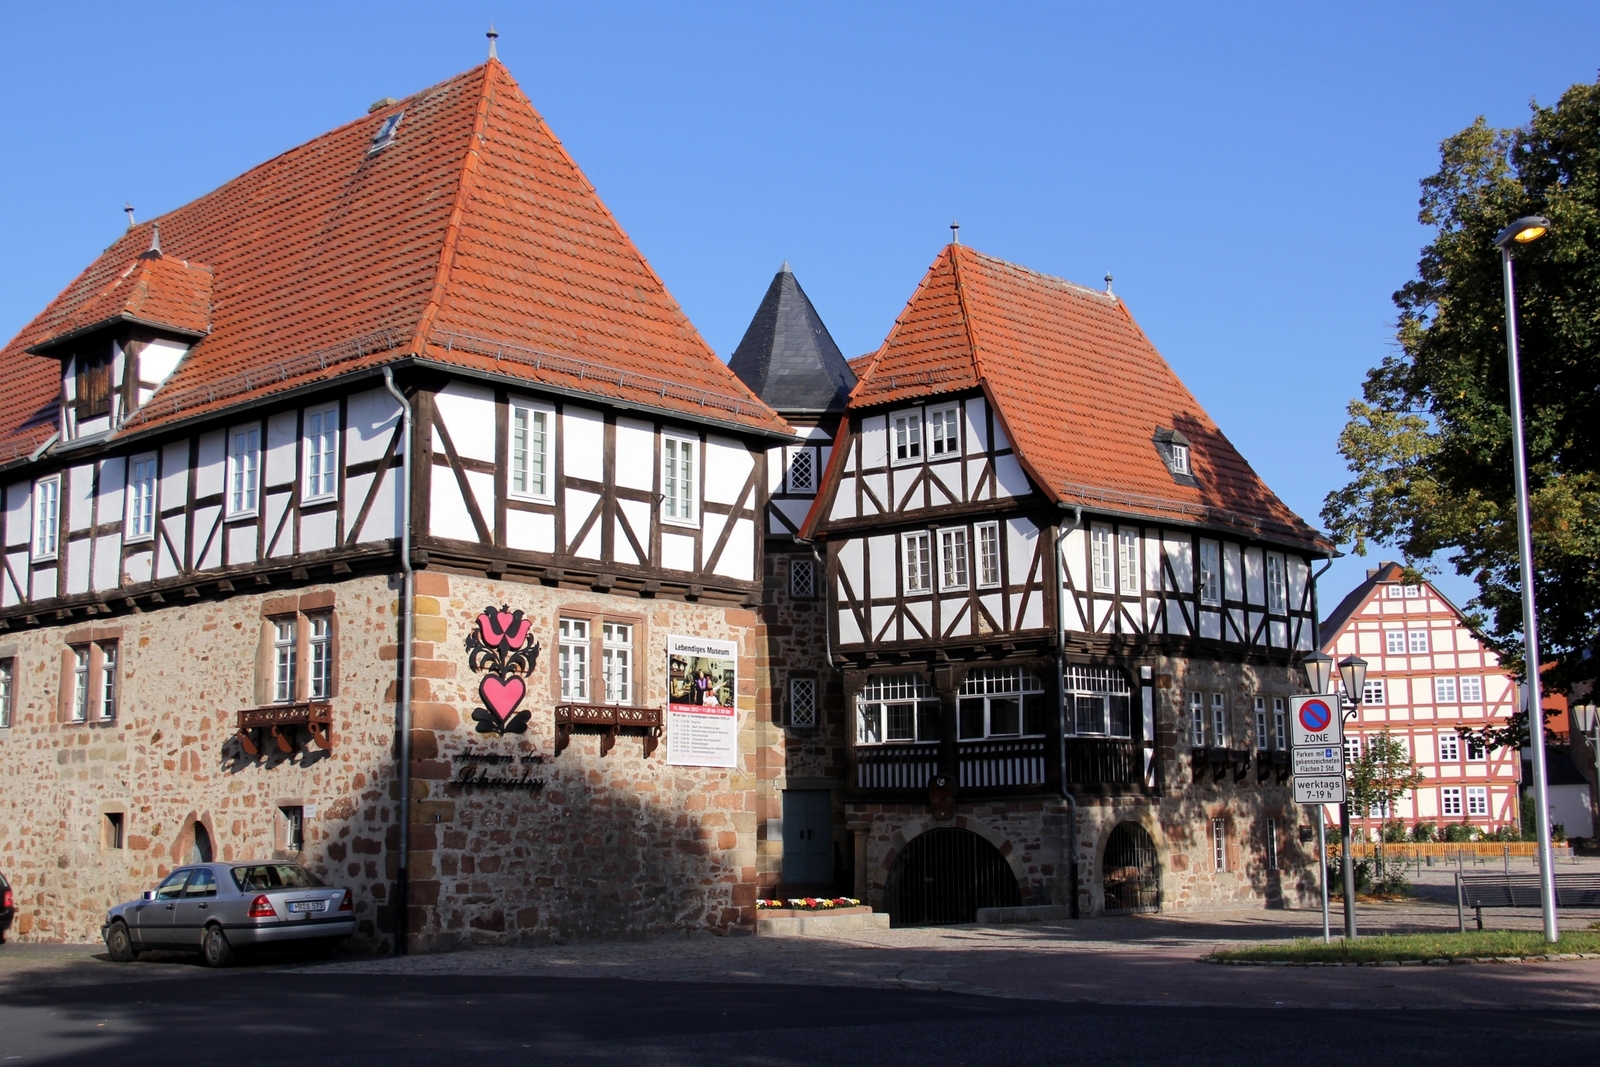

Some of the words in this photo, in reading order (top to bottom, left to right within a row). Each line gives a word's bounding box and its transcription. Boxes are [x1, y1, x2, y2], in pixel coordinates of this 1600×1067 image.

[675, 643, 706, 654] Lebendiges
[707, 646, 730, 656] Museum
[1304, 734, 1328, 742] ZONE
[454, 746, 516, 762] Museum
[1295, 758, 1340, 766] gekennzeichneten
[453, 766, 548, 790] Schwalm
[1297, 780, 1340, 790] werktags
[1306, 790, 1325, 799] 7-19
